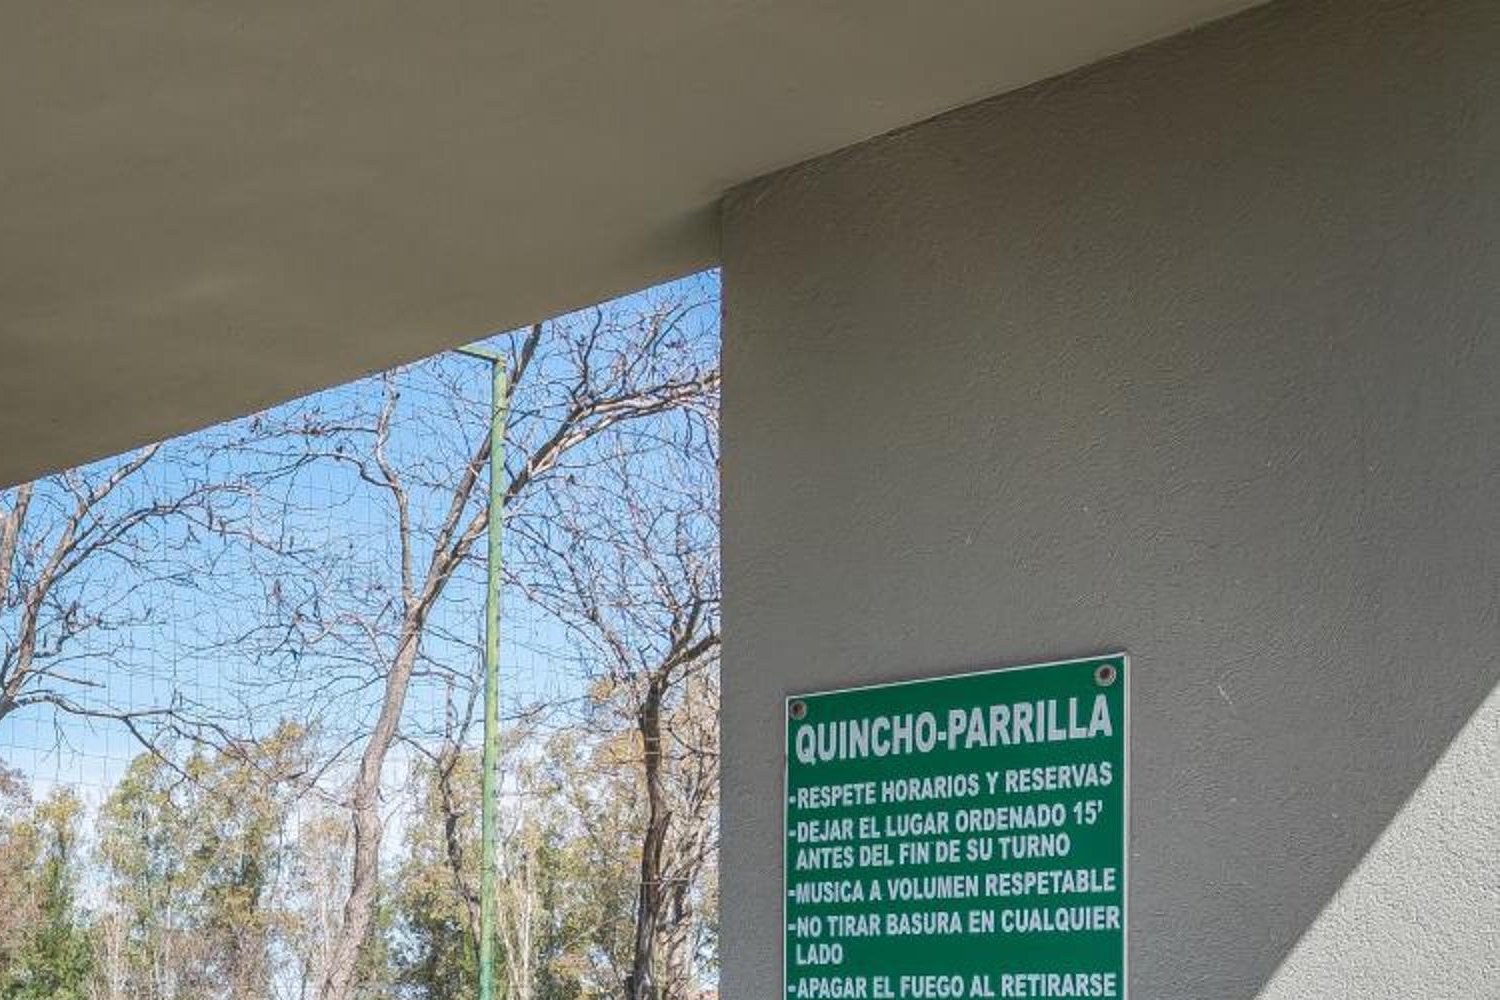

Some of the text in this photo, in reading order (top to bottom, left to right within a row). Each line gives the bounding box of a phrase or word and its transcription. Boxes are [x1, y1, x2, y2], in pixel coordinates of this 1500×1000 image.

[795, 693, 1113, 765] QUINCHO-PARRILLA
[881, 773, 980, 803] HORARIOS
[987, 772, 999, 795] Y
[1005, 762, 1113, 794] RESERVAS
[859, 817, 880, 838] EL
[886, 812, 948, 836] LUGAR
[956, 803, 1067, 832] ORDENADO
[796, 832, 1071, 871] ANTES DEL FIN DE SU TURNO
[869, 880, 882, 901] A
[887, 874, 979, 900] VOLUMEN
[985, 868, 1116, 897] RESPETABLE
[827, 913, 881, 937] TIRAR
[886, 910, 962, 934] BASURA
[969, 910, 995, 933] EN
[1001, 906, 1120, 932] CUALQUIER
[796, 944, 843, 965] LADO
[873, 976, 894, 998] EL
[900, 975, 965, 998] FUEGO
[970, 975, 995, 997] AL
[1001, 973, 1117, 997] RETIRARSE
